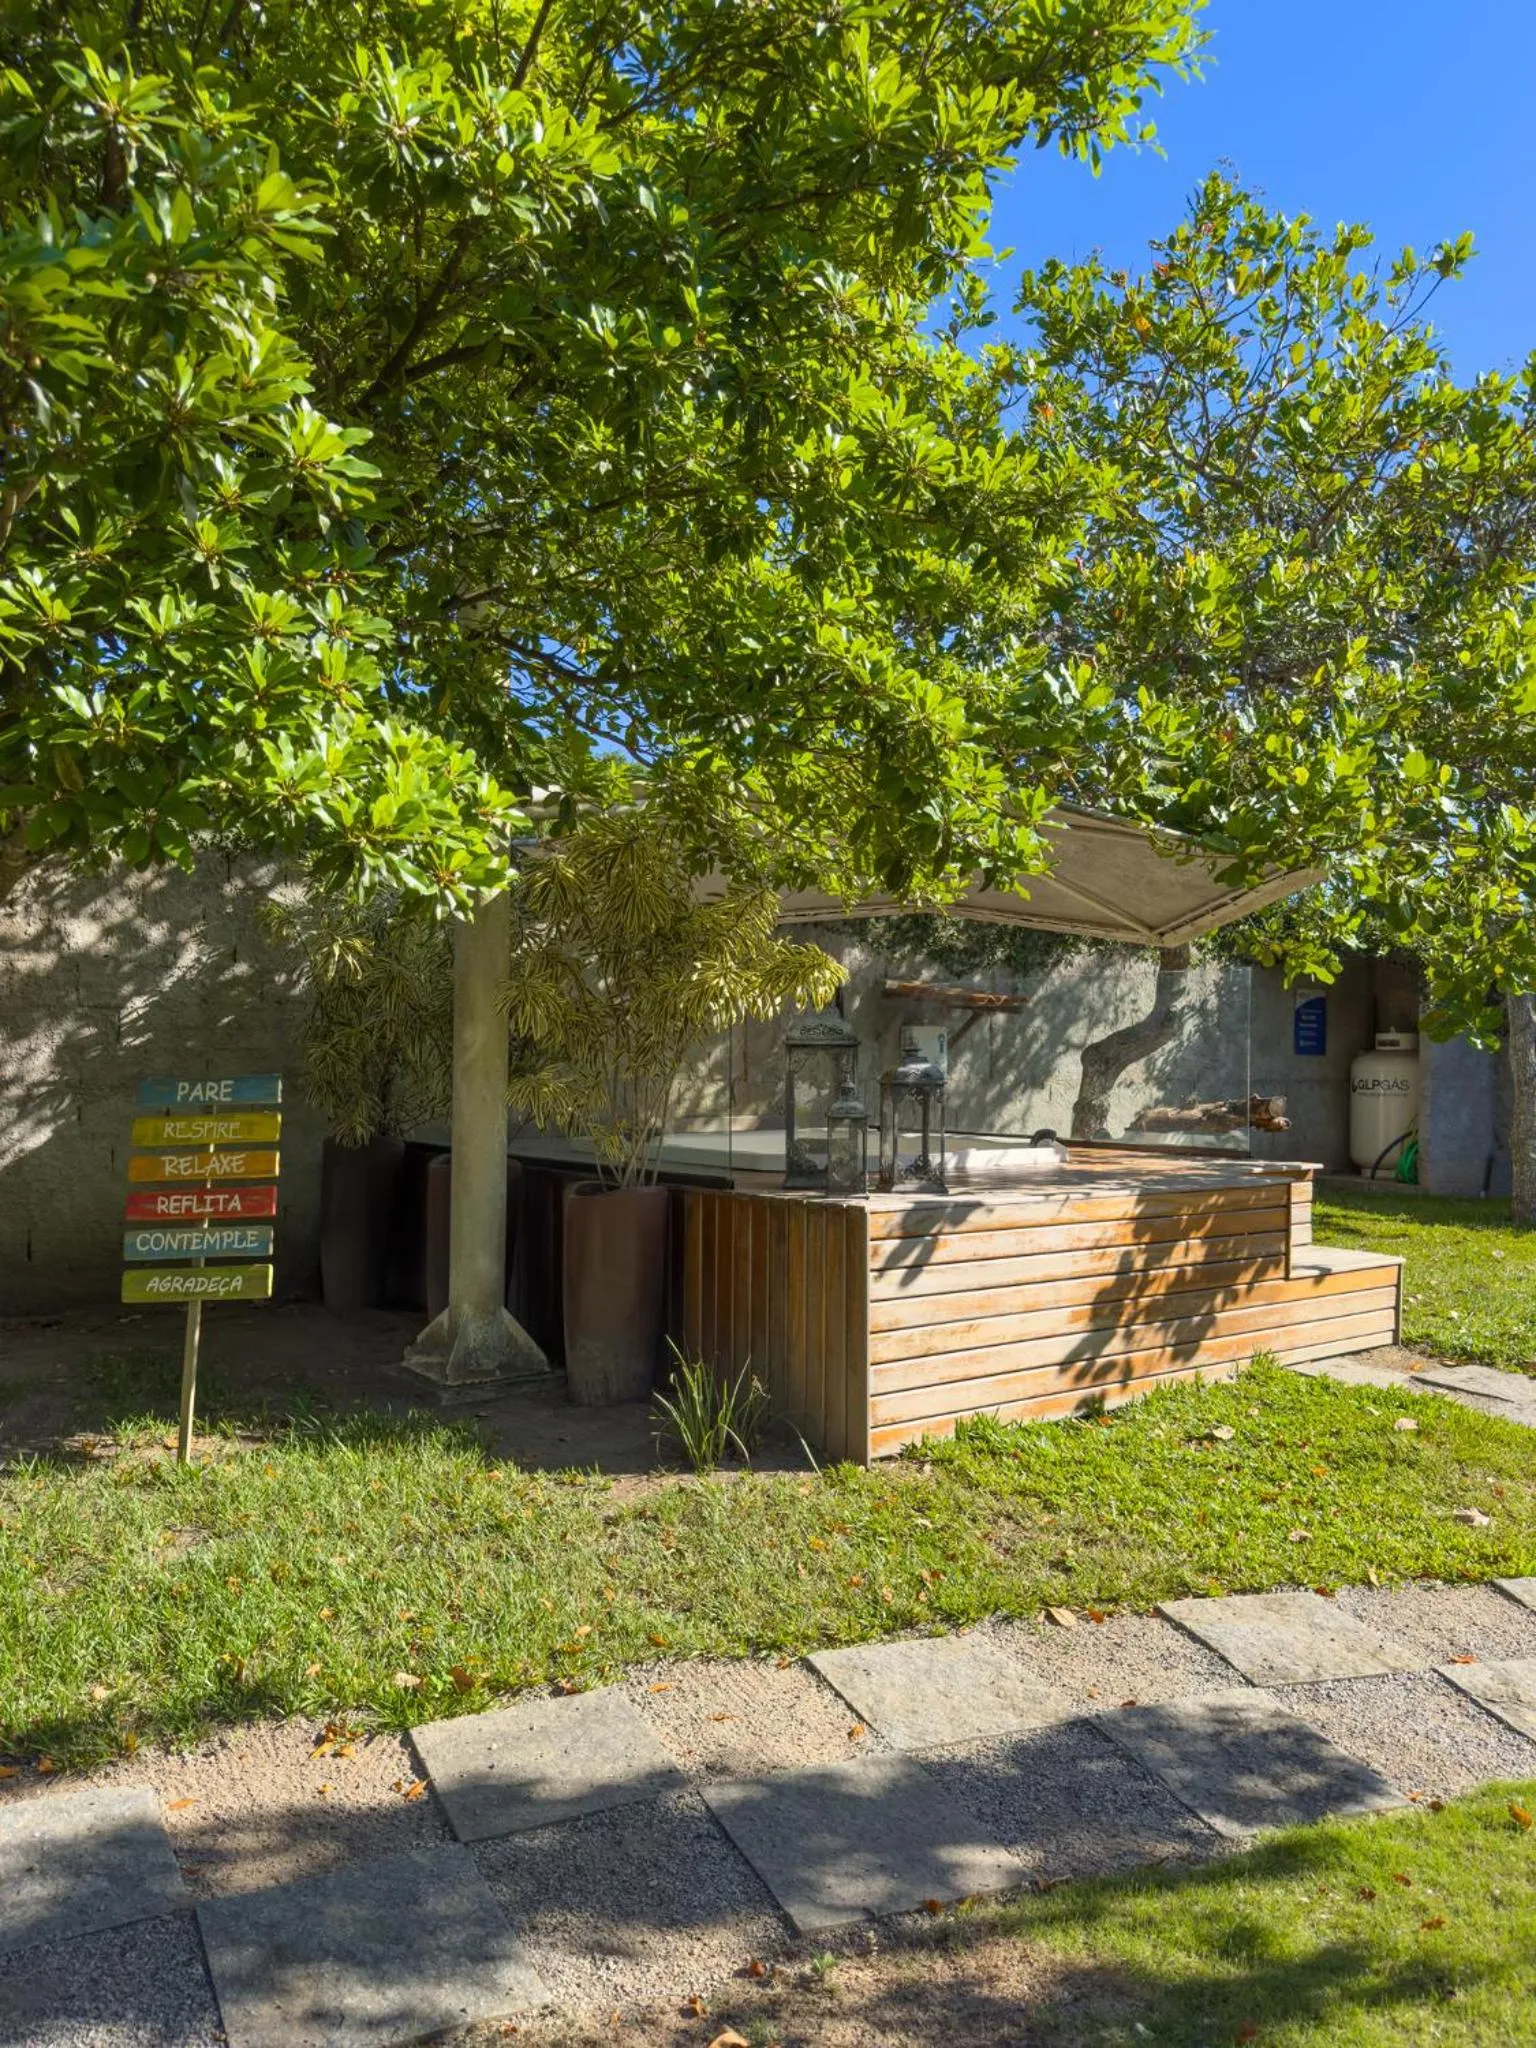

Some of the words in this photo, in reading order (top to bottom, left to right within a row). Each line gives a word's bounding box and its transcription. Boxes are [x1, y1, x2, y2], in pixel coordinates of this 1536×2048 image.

[177, 1081, 234, 1102] PARE
[163, 1121, 241, 1139] RESPIRE
[162, 1153, 246, 1177] RELAXE
[156, 1195, 242, 1214] REFLITA
[136, 1230, 259, 1251] CONTEMPLE
[146, 1275, 242, 1296] AGRADEÇA
